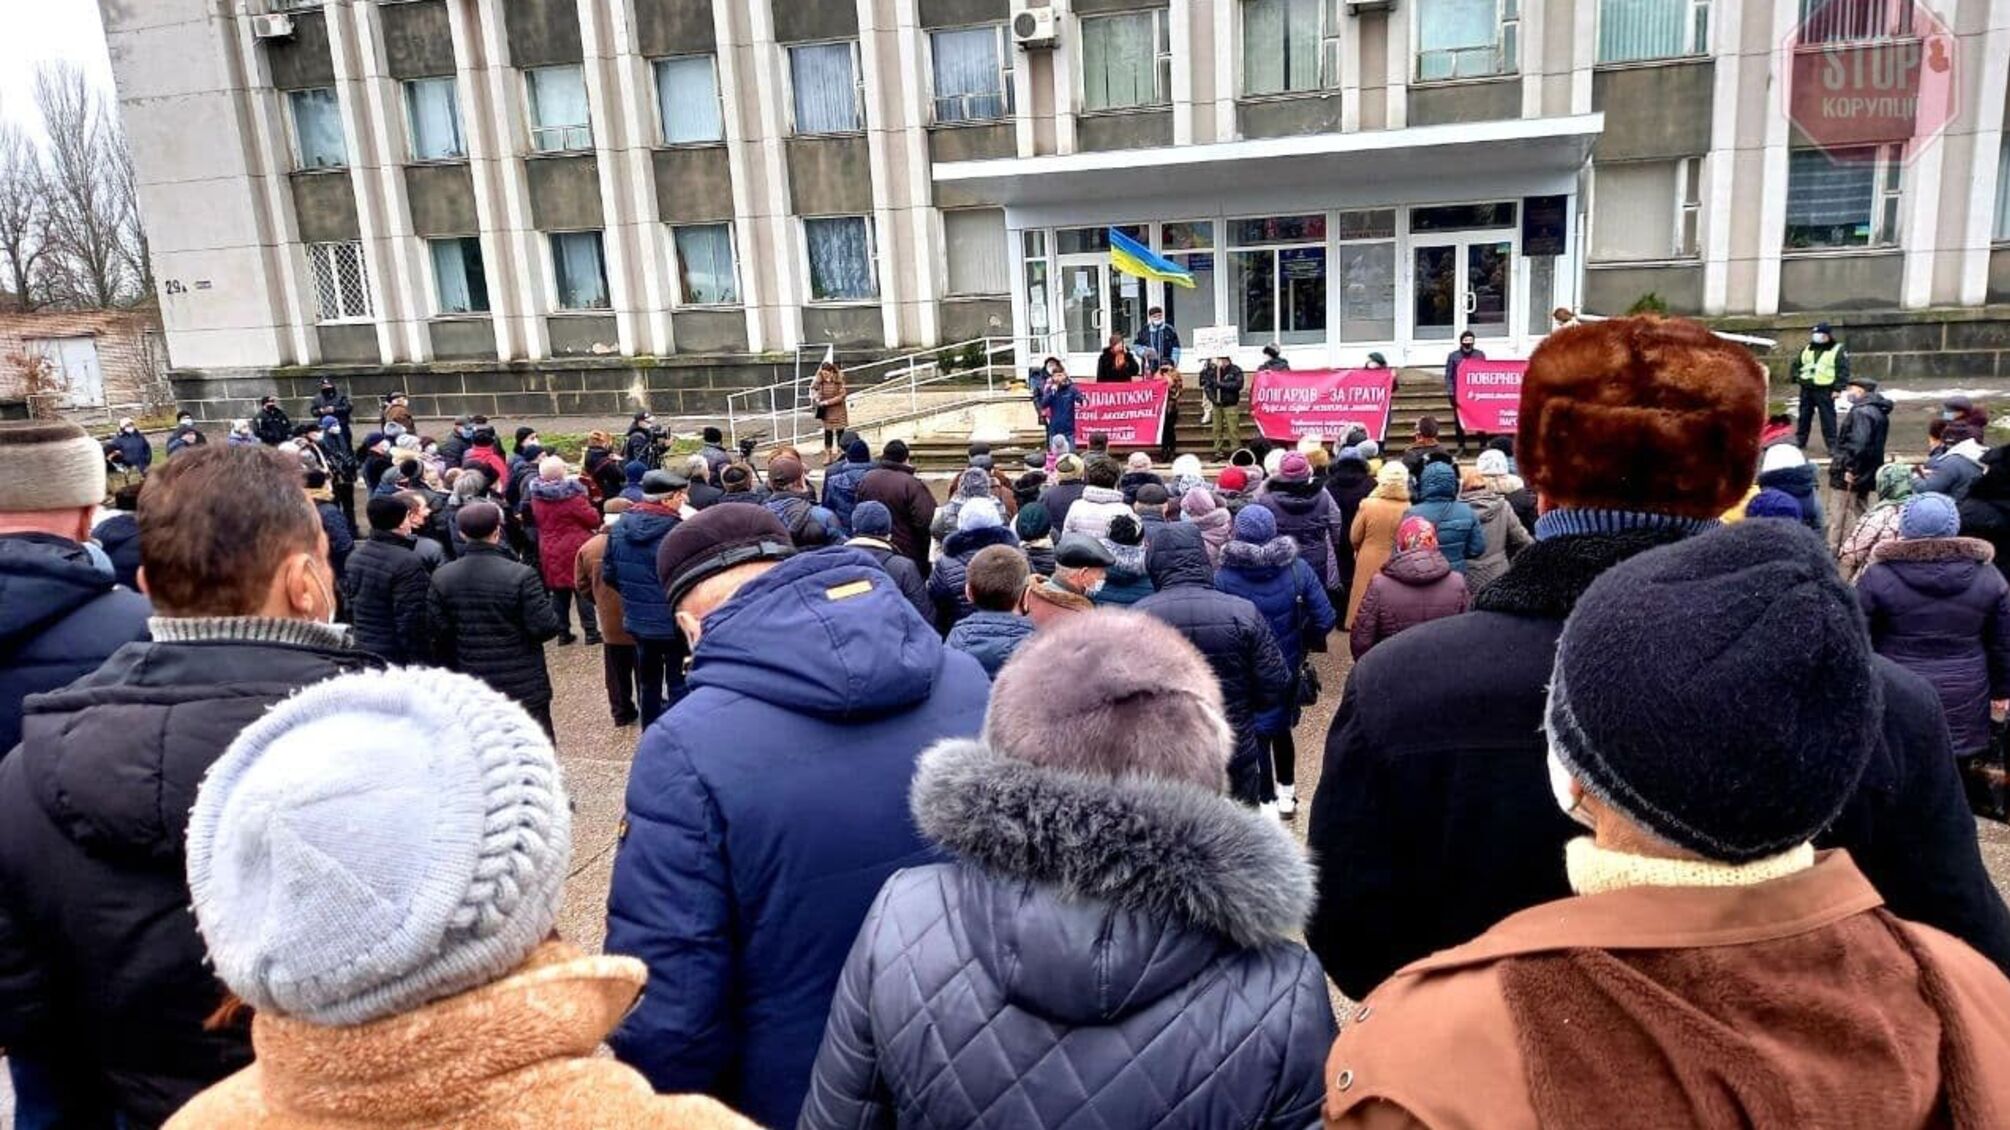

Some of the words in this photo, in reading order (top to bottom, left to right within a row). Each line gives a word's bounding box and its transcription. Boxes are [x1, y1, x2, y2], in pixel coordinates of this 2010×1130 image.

[1258, 388, 1318, 402] ОЛІГАРХІВ
[1329, 388, 1345, 401] ЗА
[1349, 387, 1386, 402] ГРАТИ
